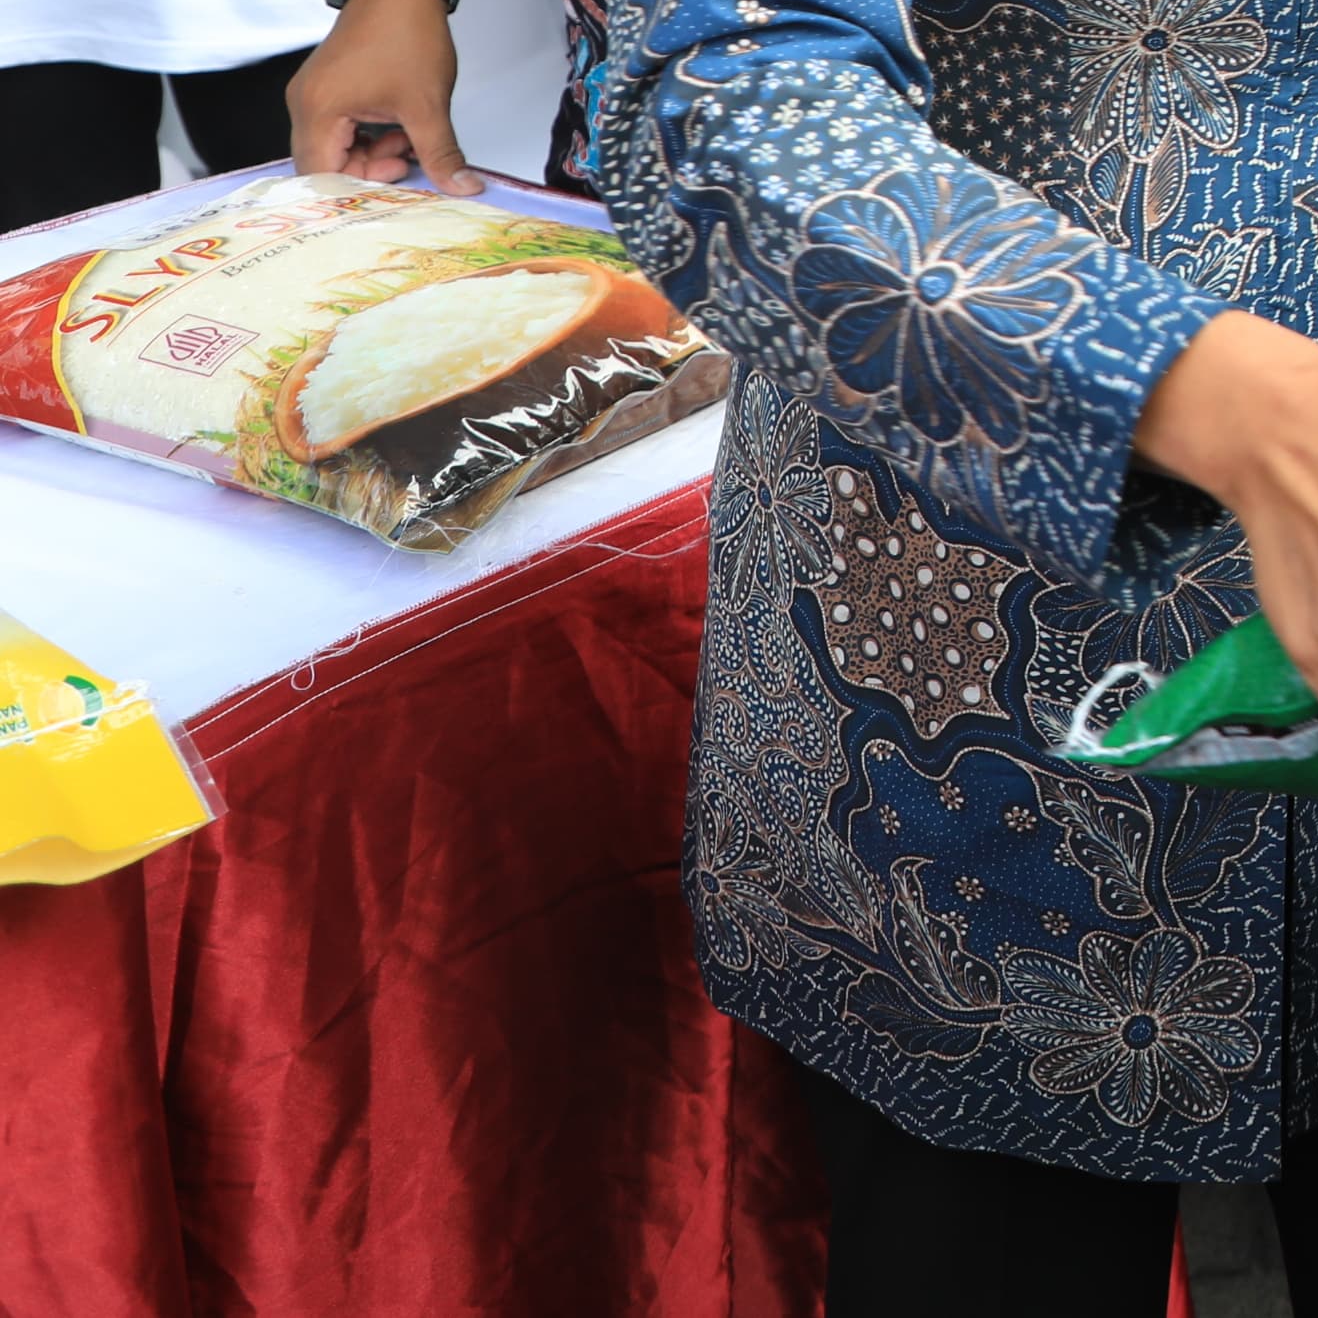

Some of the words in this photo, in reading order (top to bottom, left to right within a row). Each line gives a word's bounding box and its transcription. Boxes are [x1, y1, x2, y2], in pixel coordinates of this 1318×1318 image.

[220, 240, 291, 279] Beras
[59, 236, 227, 343] SLYP
[195, 332, 238, 366] HALAL
